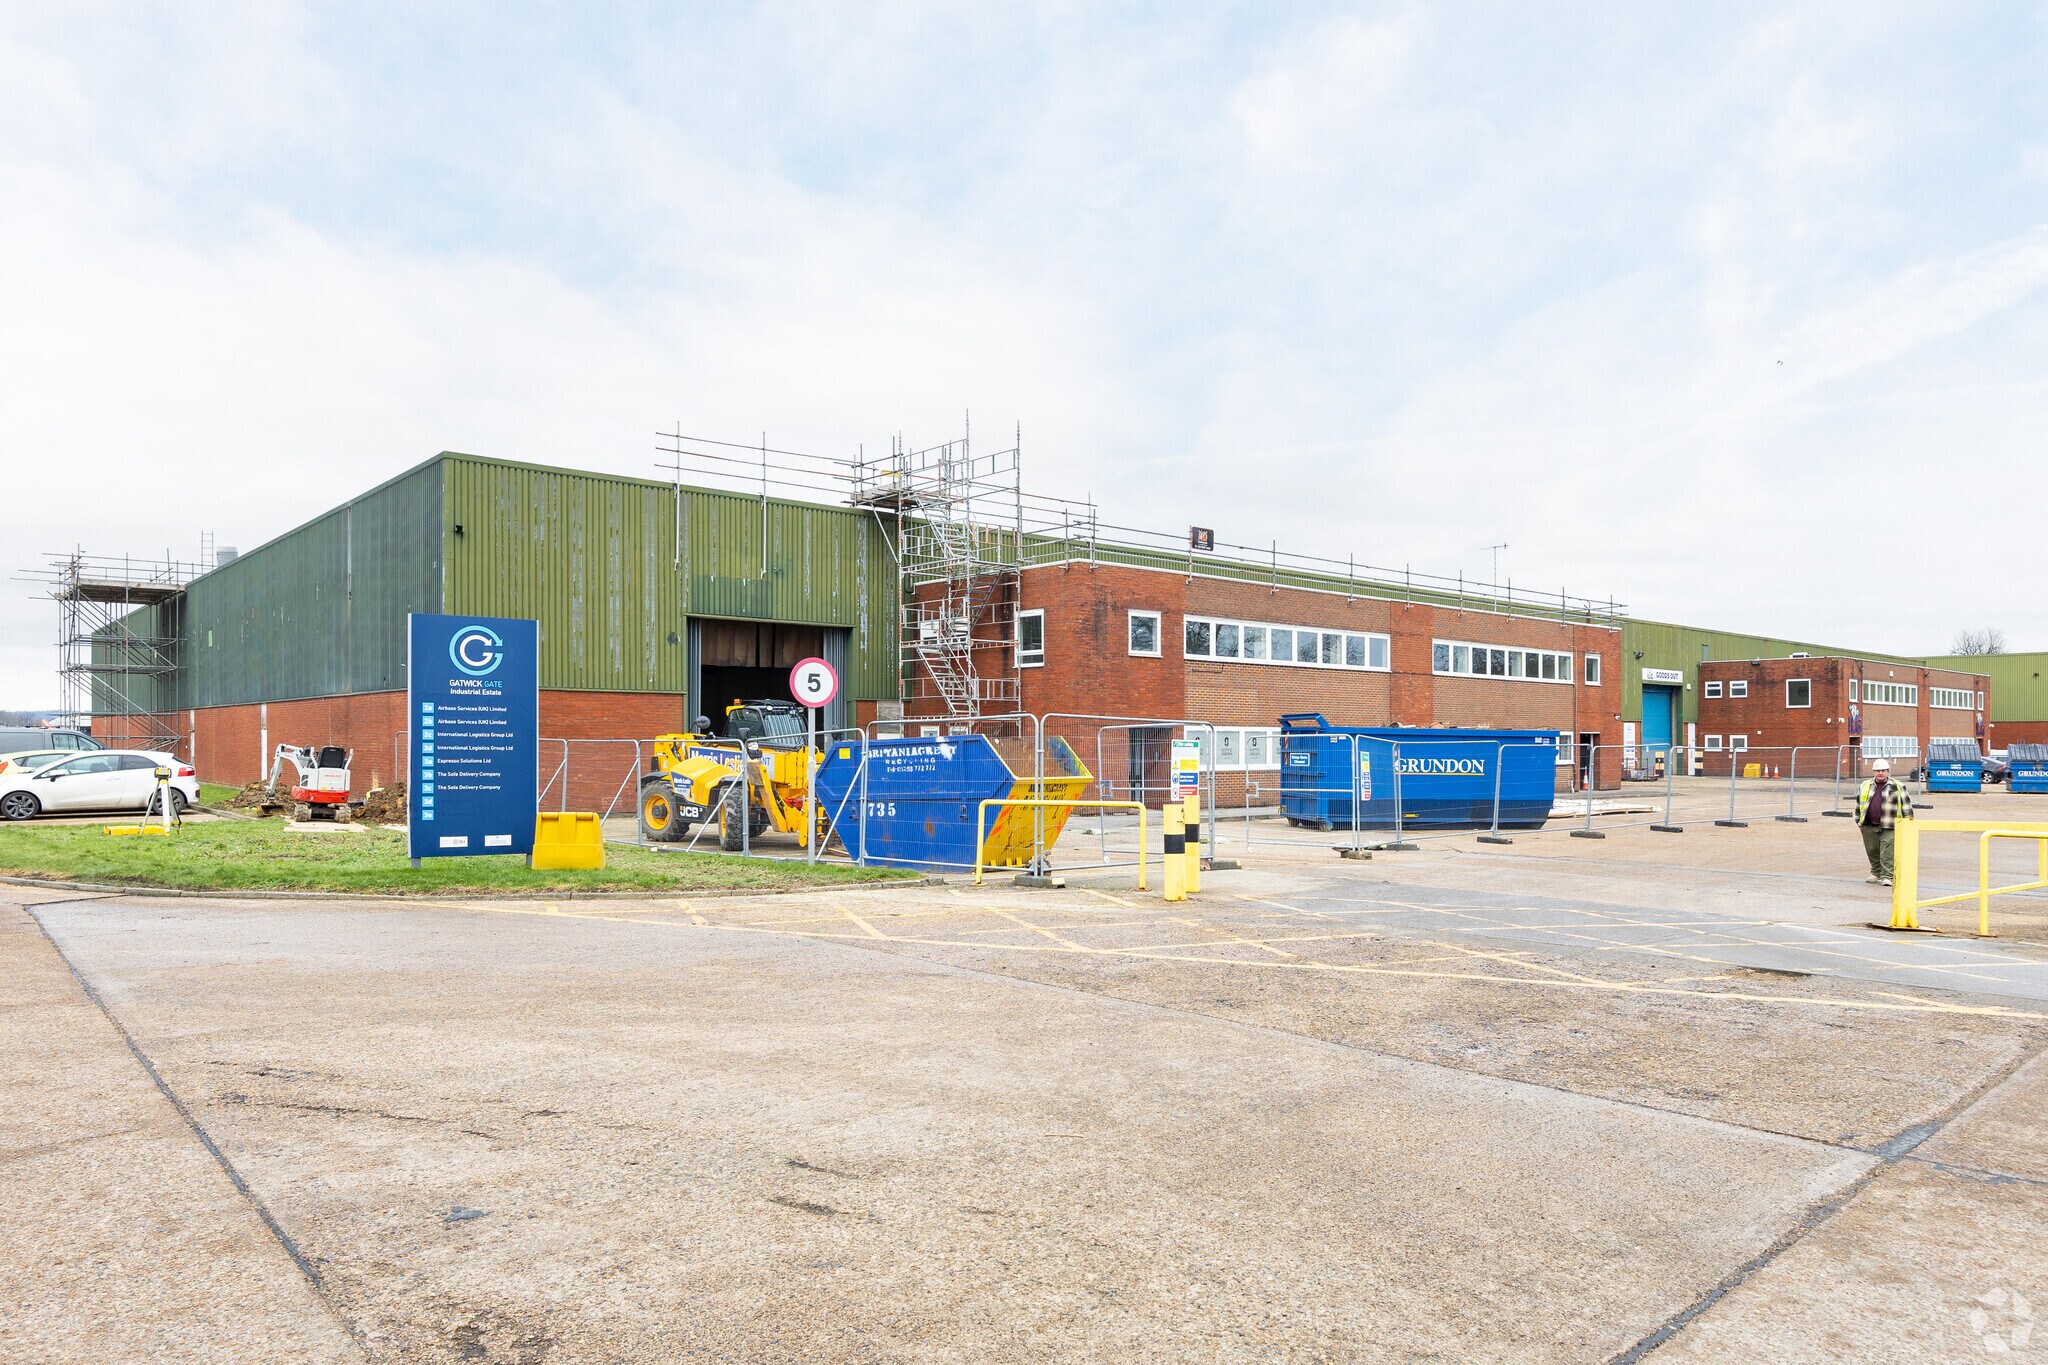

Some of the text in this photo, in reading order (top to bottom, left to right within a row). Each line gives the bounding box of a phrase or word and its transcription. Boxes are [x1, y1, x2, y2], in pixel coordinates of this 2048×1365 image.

[807, 673, 821, 692] 5
[1656, 671, 1670, 679] GOODS
[449, 679, 503, 688] GATWICK GATE
[691, 749, 719, 764] Mrris
[868, 745, 957, 760] BRITANIACRET
[1395, 758, 1485, 773] GRUNDON
[679, 805, 699, 818] JCB
[867, 802, 896, 817] 735
